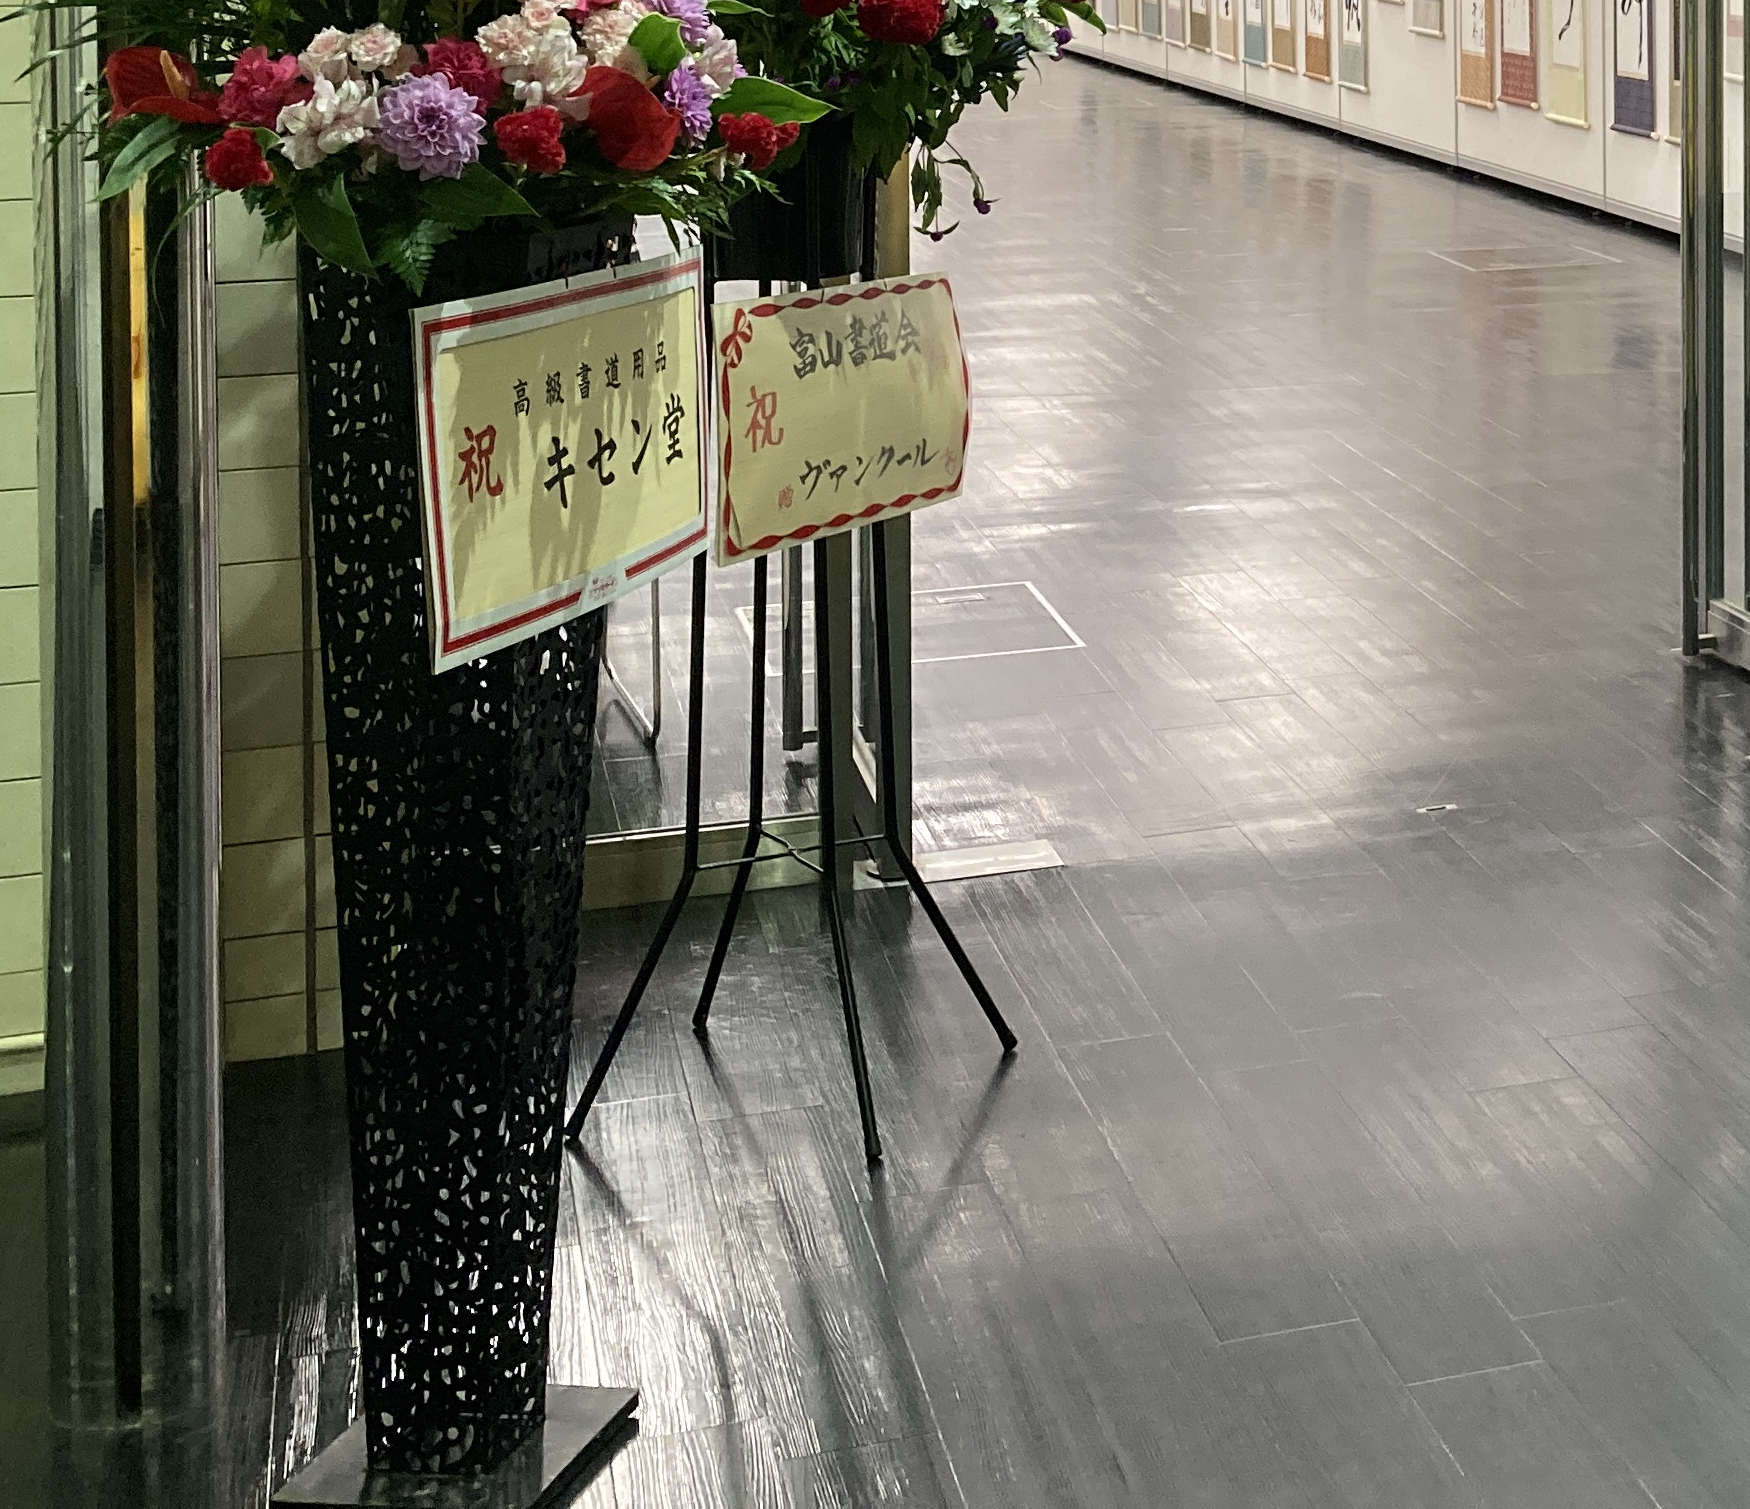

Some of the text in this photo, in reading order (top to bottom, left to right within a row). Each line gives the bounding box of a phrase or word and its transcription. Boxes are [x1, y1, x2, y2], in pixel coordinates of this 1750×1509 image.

[513, 341, 667, 418] 高級書道用品
[543, 392, 685, 509] キセン堂
[745, 386, 785, 453] 祝
[457, 424, 504, 504] 祝
[798, 441, 940, 502] ヴァンクール
